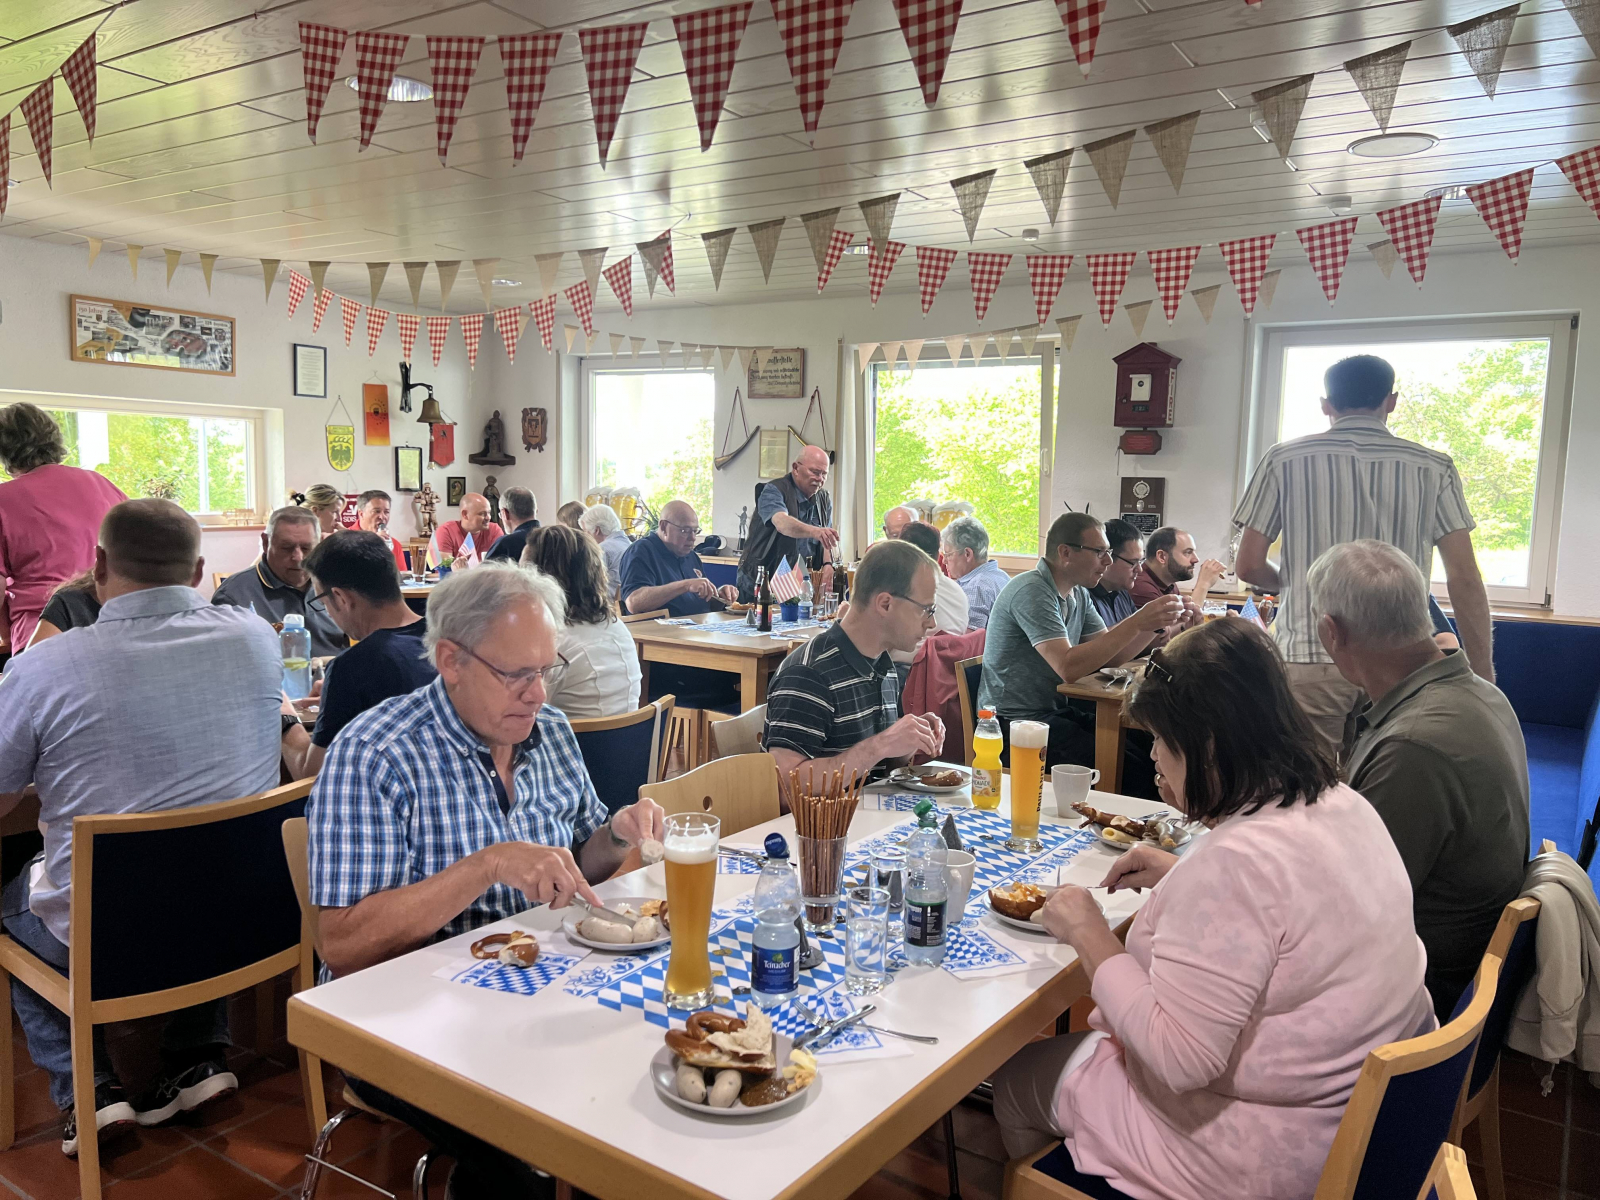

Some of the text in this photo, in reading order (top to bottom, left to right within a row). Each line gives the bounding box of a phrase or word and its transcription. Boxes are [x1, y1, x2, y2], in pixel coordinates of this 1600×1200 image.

[88, 306, 103, 314] Jahre
[1167, 371, 1175, 421] FIRE
[763, 960, 791, 969] Teinacher
